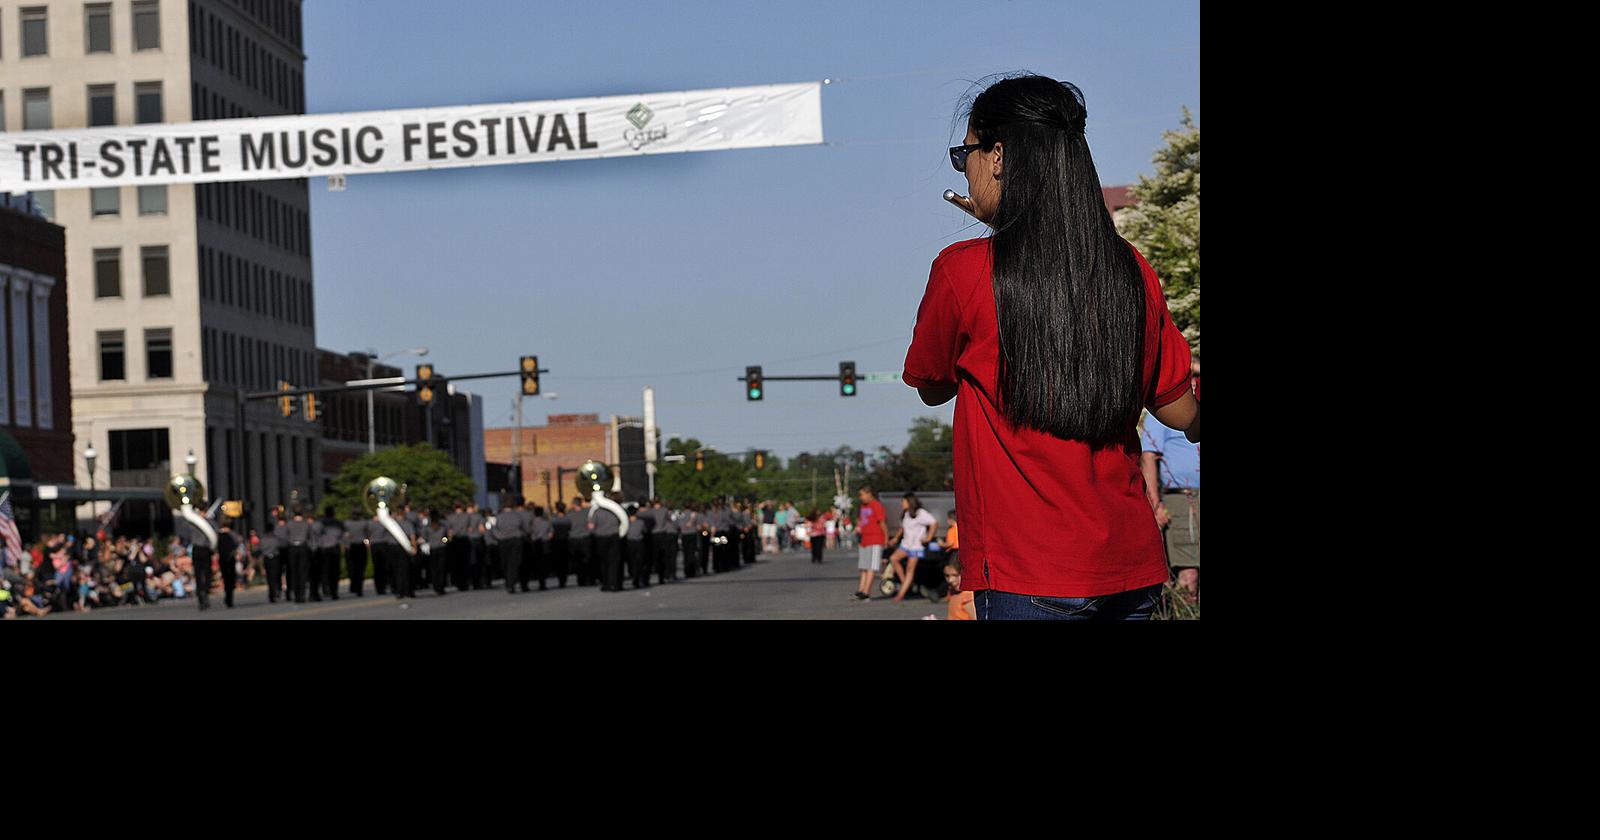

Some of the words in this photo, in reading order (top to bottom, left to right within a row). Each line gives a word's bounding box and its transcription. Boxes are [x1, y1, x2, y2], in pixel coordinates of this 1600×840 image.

[15, 135, 220, 182] TRI-STATE
[240, 126, 385, 171] MUSIC
[403, 112, 599, 162] FESTIVAL
